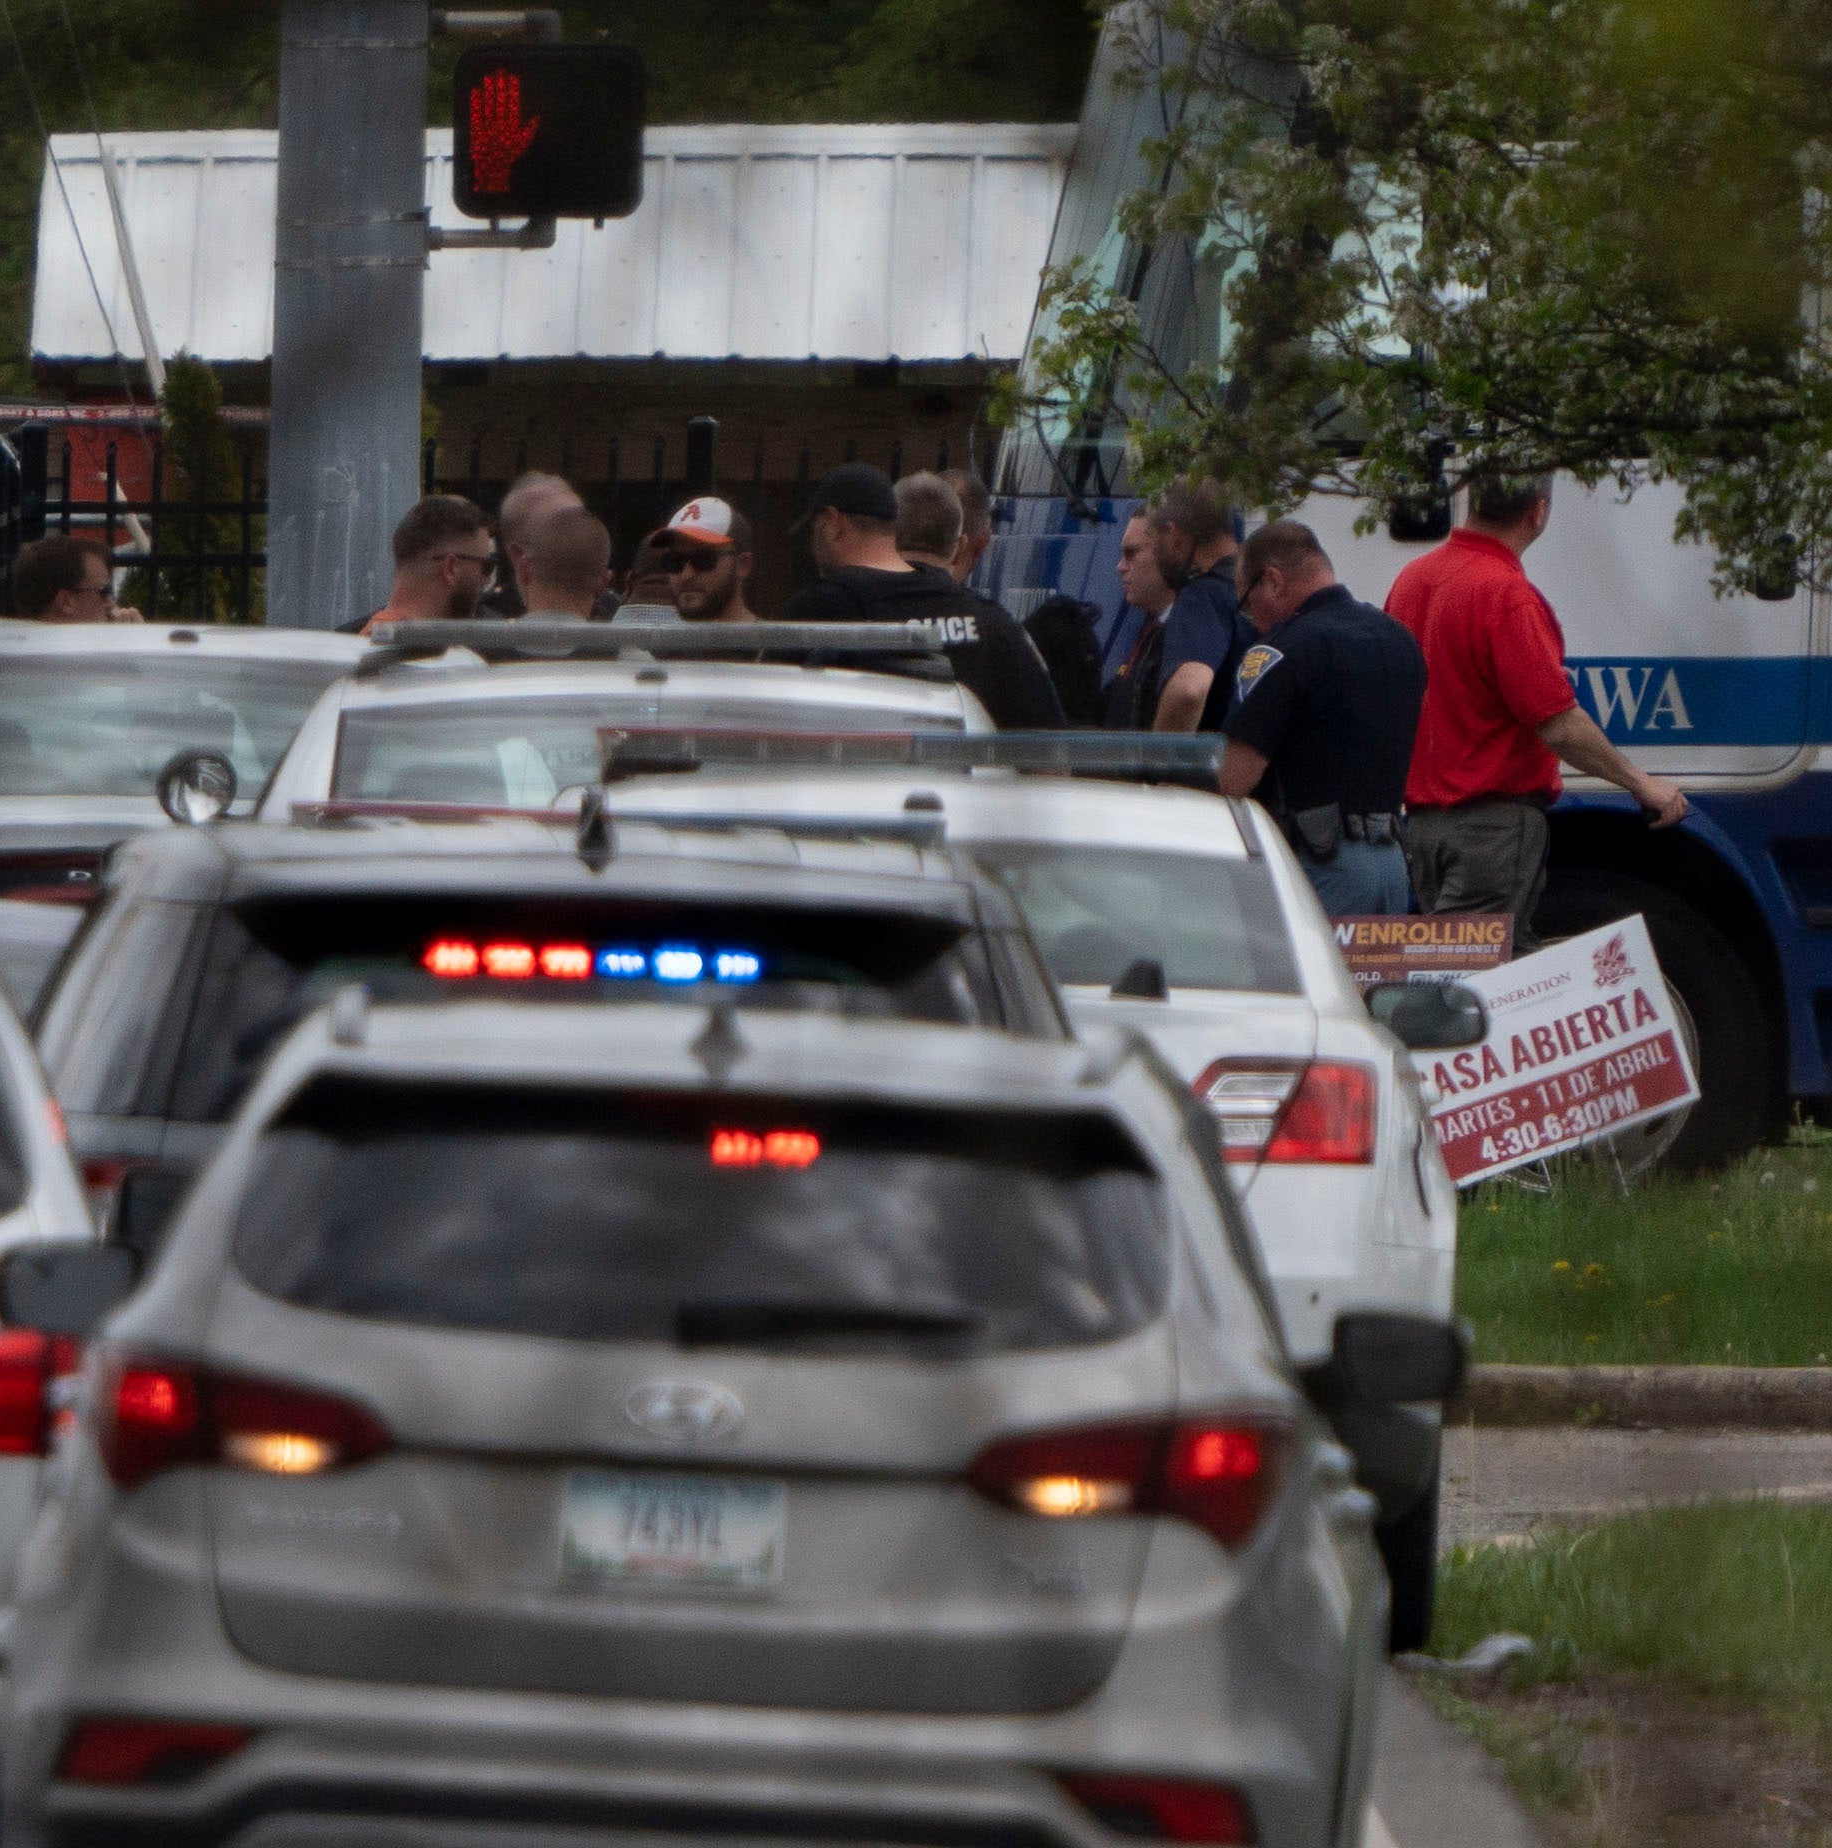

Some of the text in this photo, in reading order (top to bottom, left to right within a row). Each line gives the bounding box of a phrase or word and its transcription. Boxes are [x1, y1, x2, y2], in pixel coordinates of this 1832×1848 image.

[1564, 666, 1694, 731] WA
[1355, 921, 1507, 945] ENROLLING
[1489, 970, 1573, 1010] ENERATION
[1421, 987, 1659, 1097] ASA ABIERTA
[1535, 1083, 1558, 1108] 11
[1568, 1068, 1600, 1099] DE
[1604, 1040, 1671, 1086] ABRIL
[1480, 1085, 1640, 1163] 4:30-6:30PM
